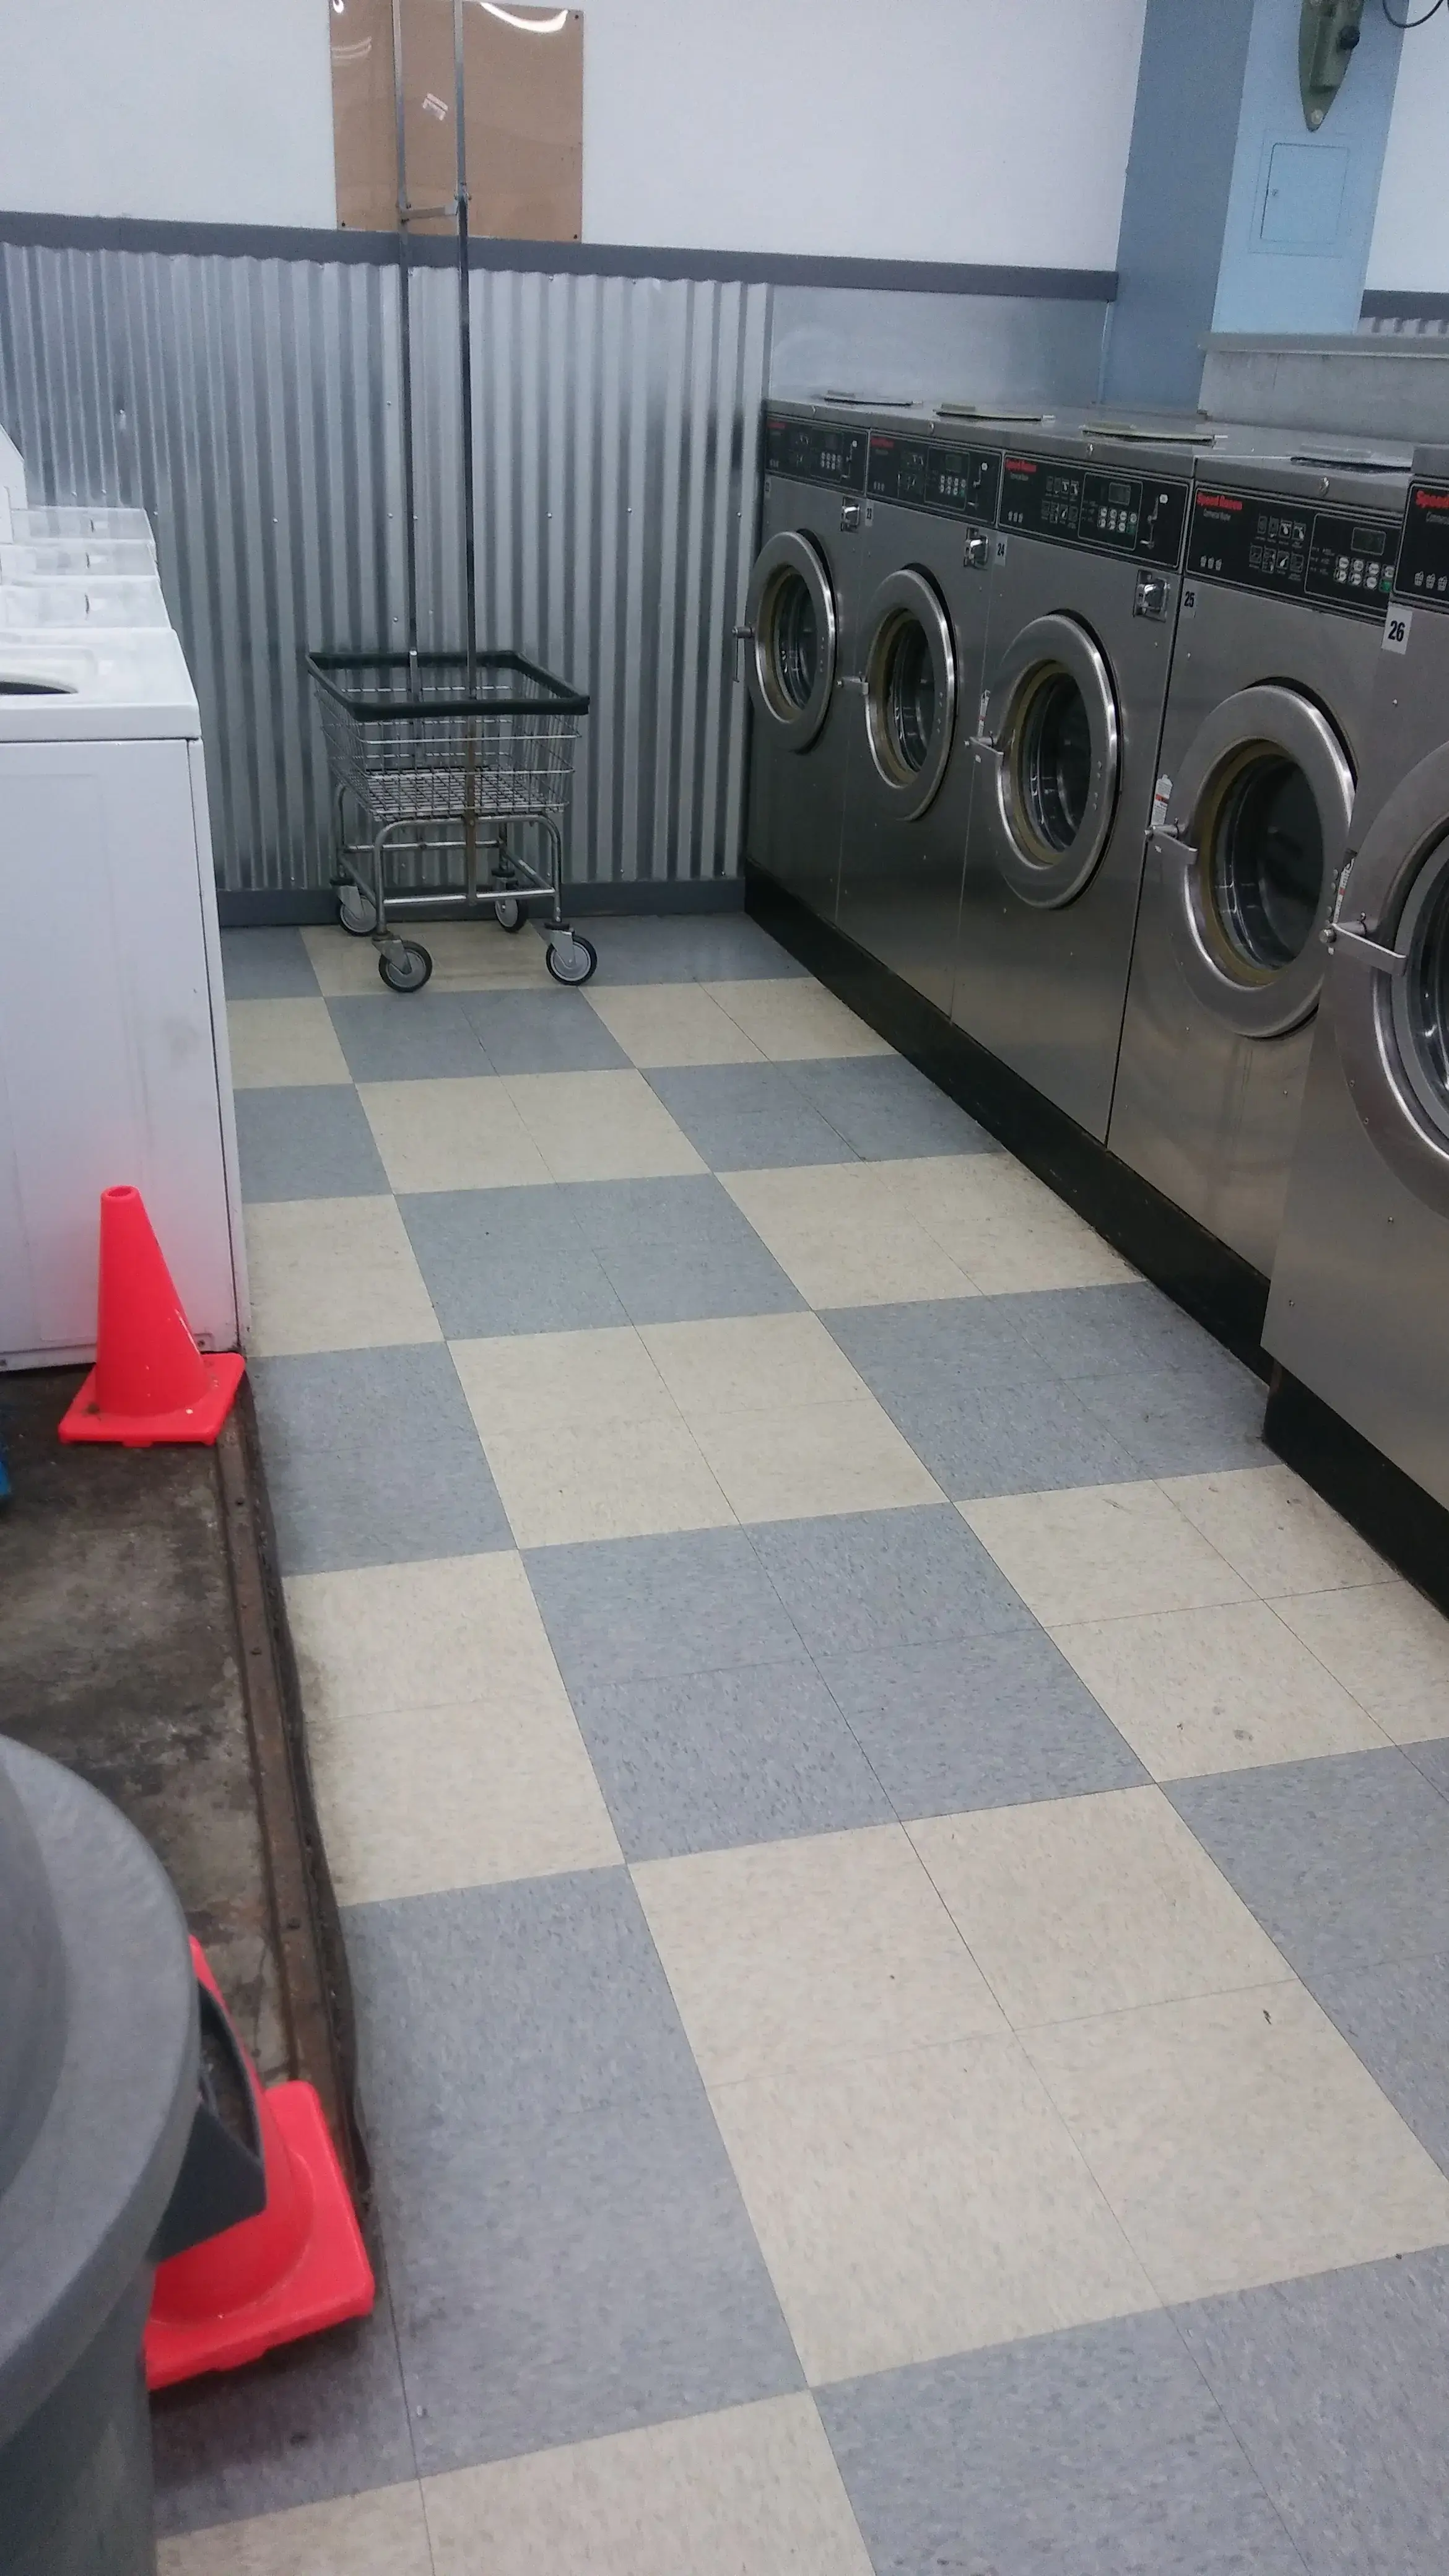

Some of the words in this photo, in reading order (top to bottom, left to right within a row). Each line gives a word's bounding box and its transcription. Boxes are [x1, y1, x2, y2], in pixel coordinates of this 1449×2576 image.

[866, 507, 872, 520] 23
[997, 542, 1005, 557] 24
[1183, 590, 1195, 607] 25
[1387, 619, 1406, 642] 26
